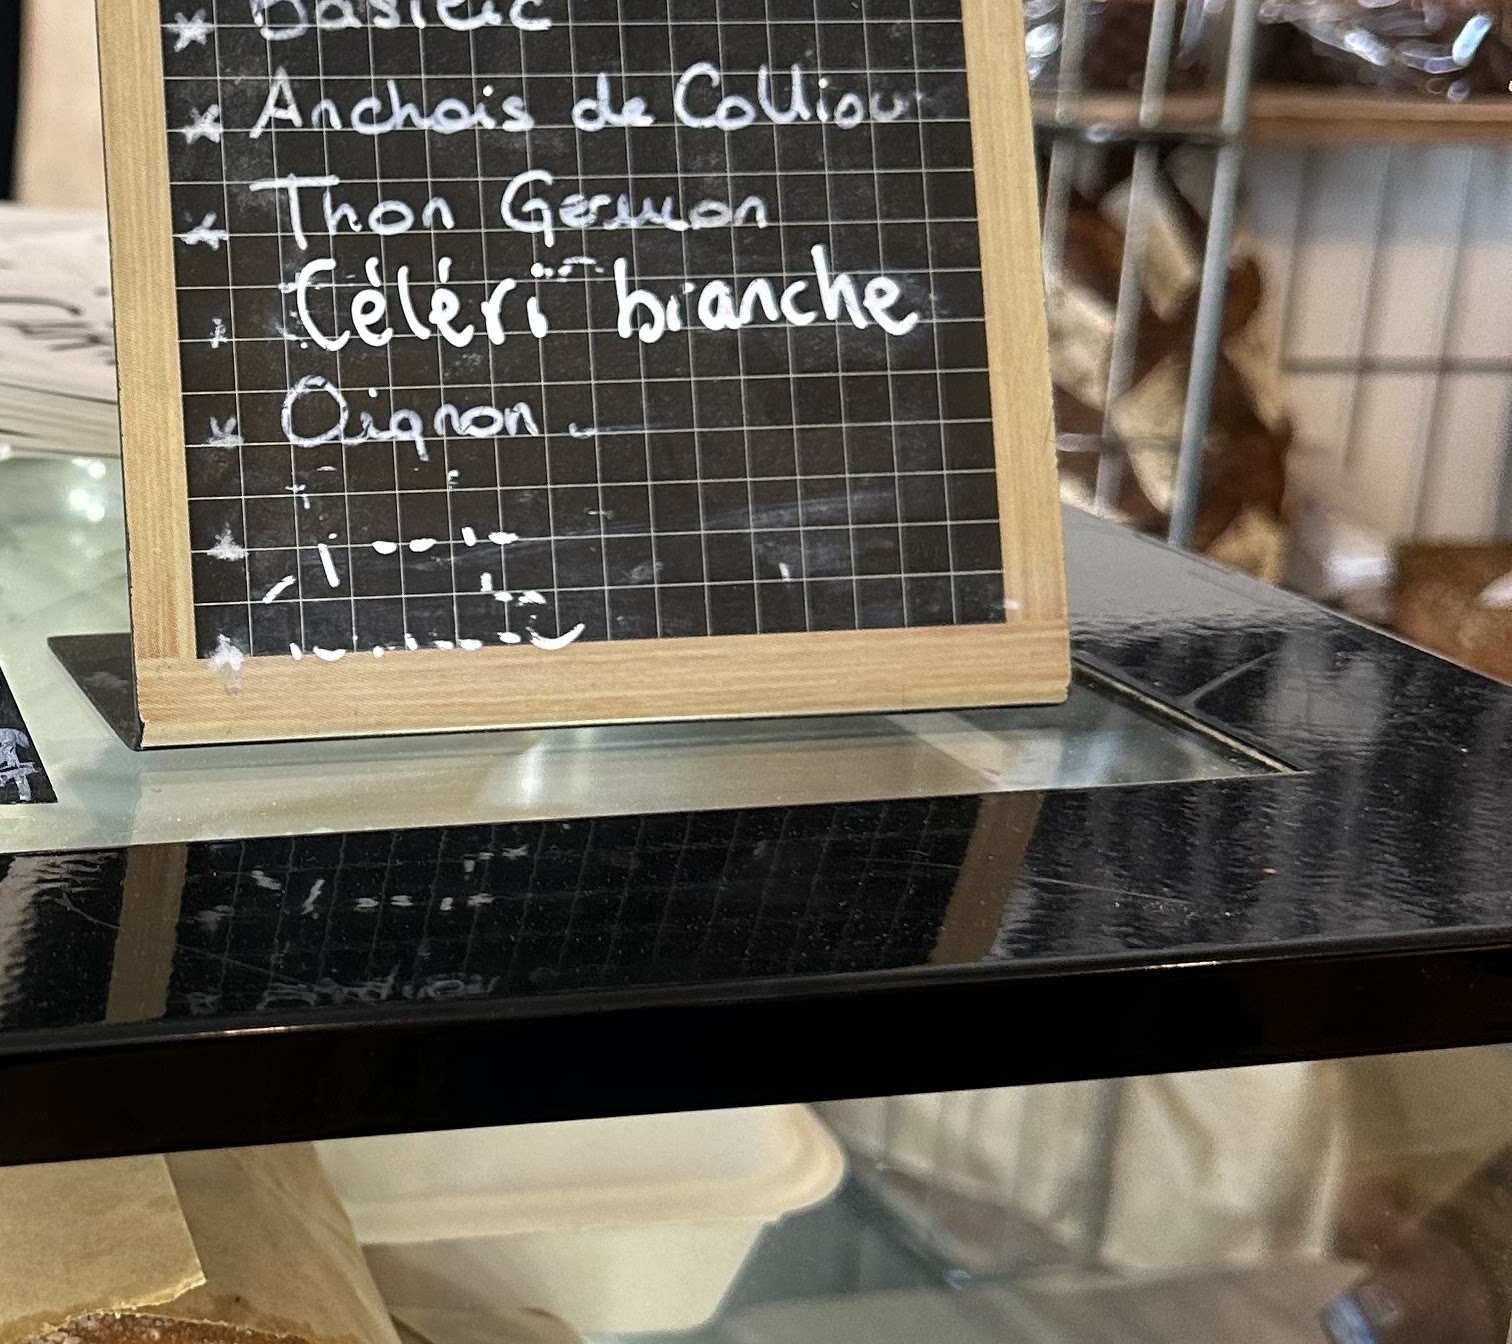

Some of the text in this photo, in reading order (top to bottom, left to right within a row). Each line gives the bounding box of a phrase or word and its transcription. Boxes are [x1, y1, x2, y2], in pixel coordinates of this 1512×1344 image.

[248, 69, 536, 141] Anchois
[570, 71, 656, 132] de
[248, 173, 458, 251] Thon
[280, 374, 541, 462] Oignon
